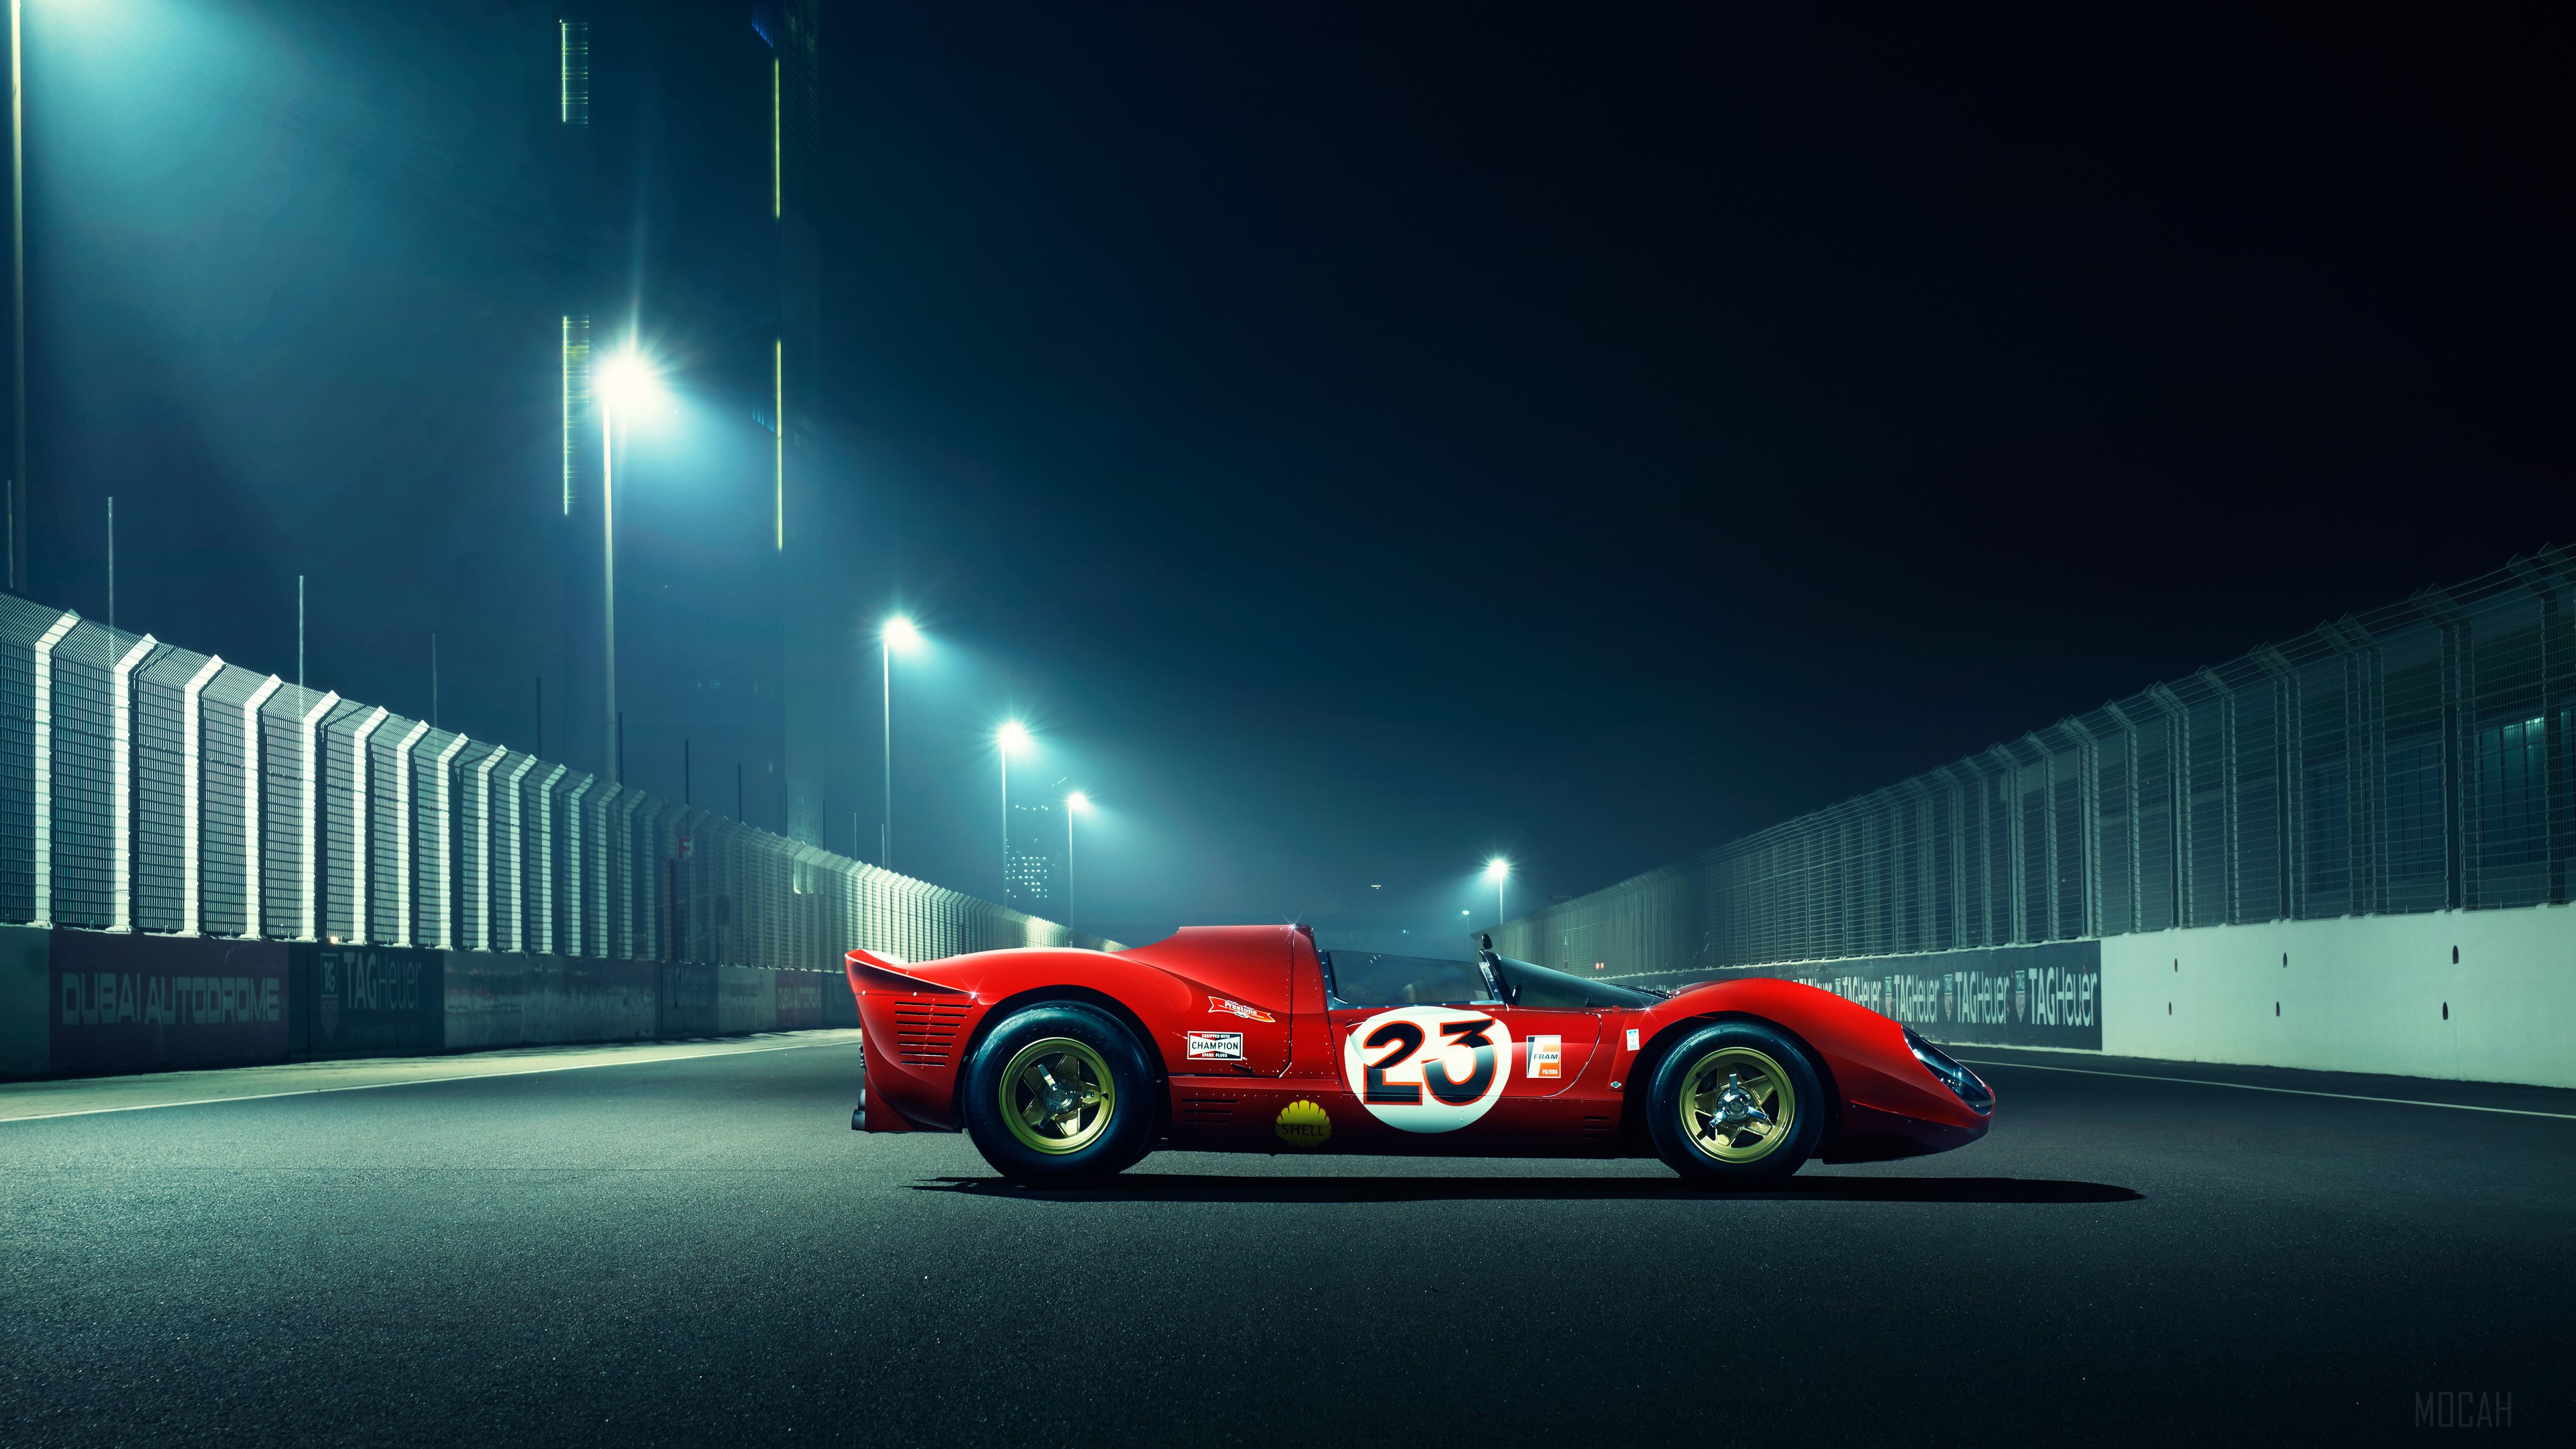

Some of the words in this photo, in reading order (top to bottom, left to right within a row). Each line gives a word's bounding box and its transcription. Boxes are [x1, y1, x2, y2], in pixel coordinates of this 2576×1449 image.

[62, 973, 141, 1025] DUBAI
[144, 976, 280, 1025] AUTODROME
[1224, 1000, 1257, 1016] Prestone
[1191, 1041, 1238, 1050] CHAMPION
[1362, 1017, 1498, 1106] 23
[1281, 1124, 1325, 1136] SHELL
